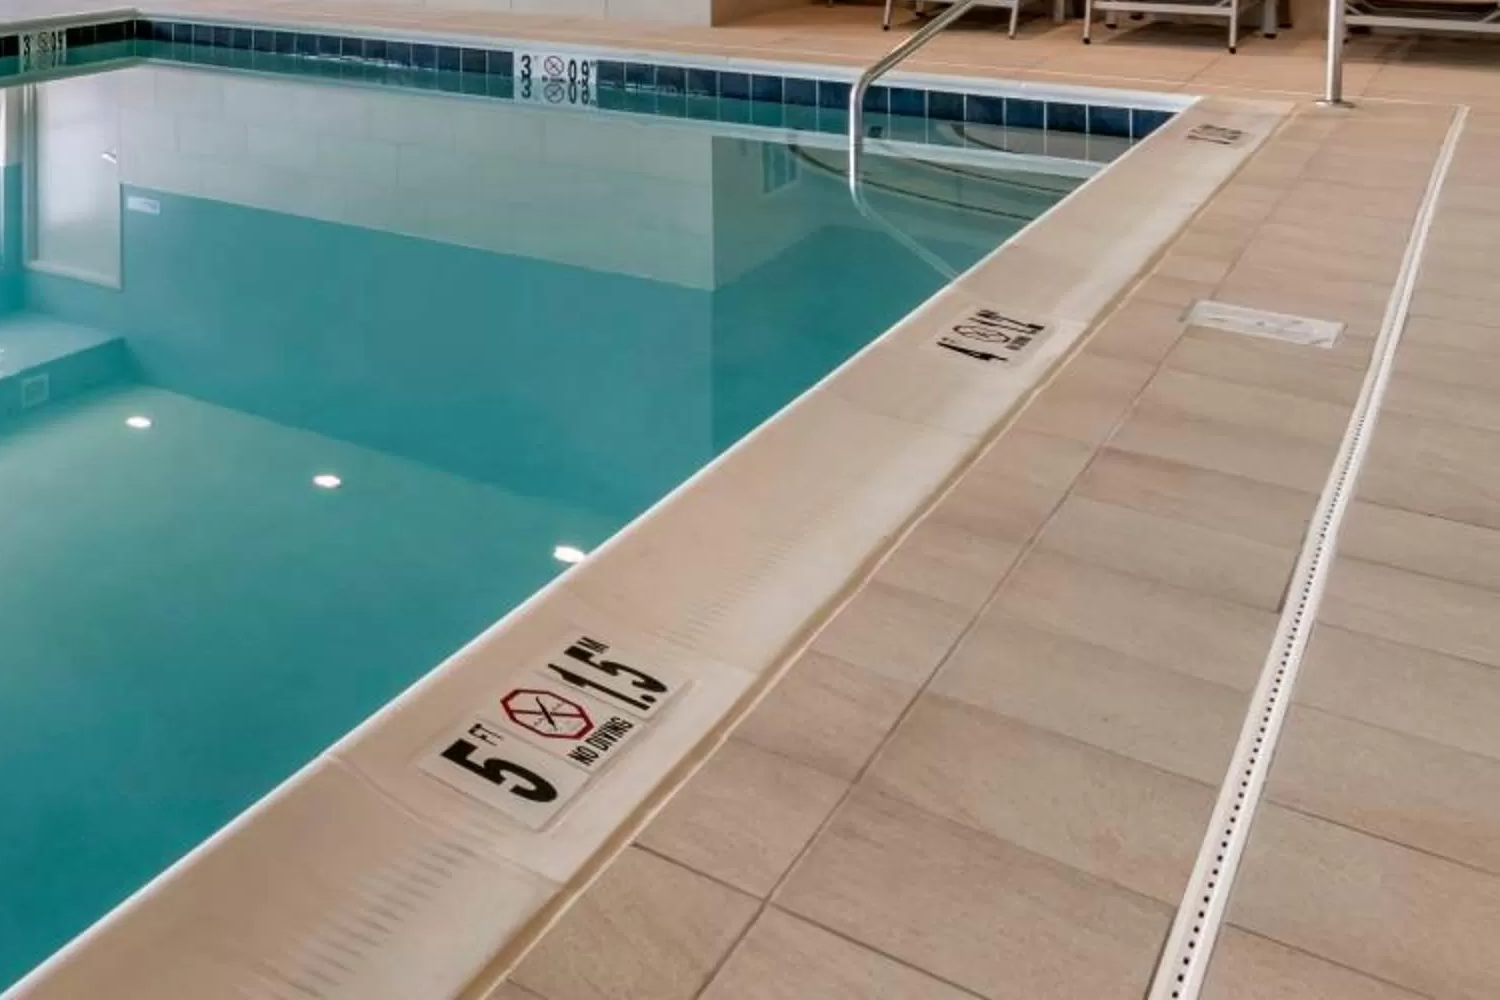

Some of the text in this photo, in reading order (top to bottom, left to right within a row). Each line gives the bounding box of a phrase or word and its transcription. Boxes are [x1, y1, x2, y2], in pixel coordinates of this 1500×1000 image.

[520, 53, 532, 80] 3
[566, 716, 634, 767] NO DIVING
